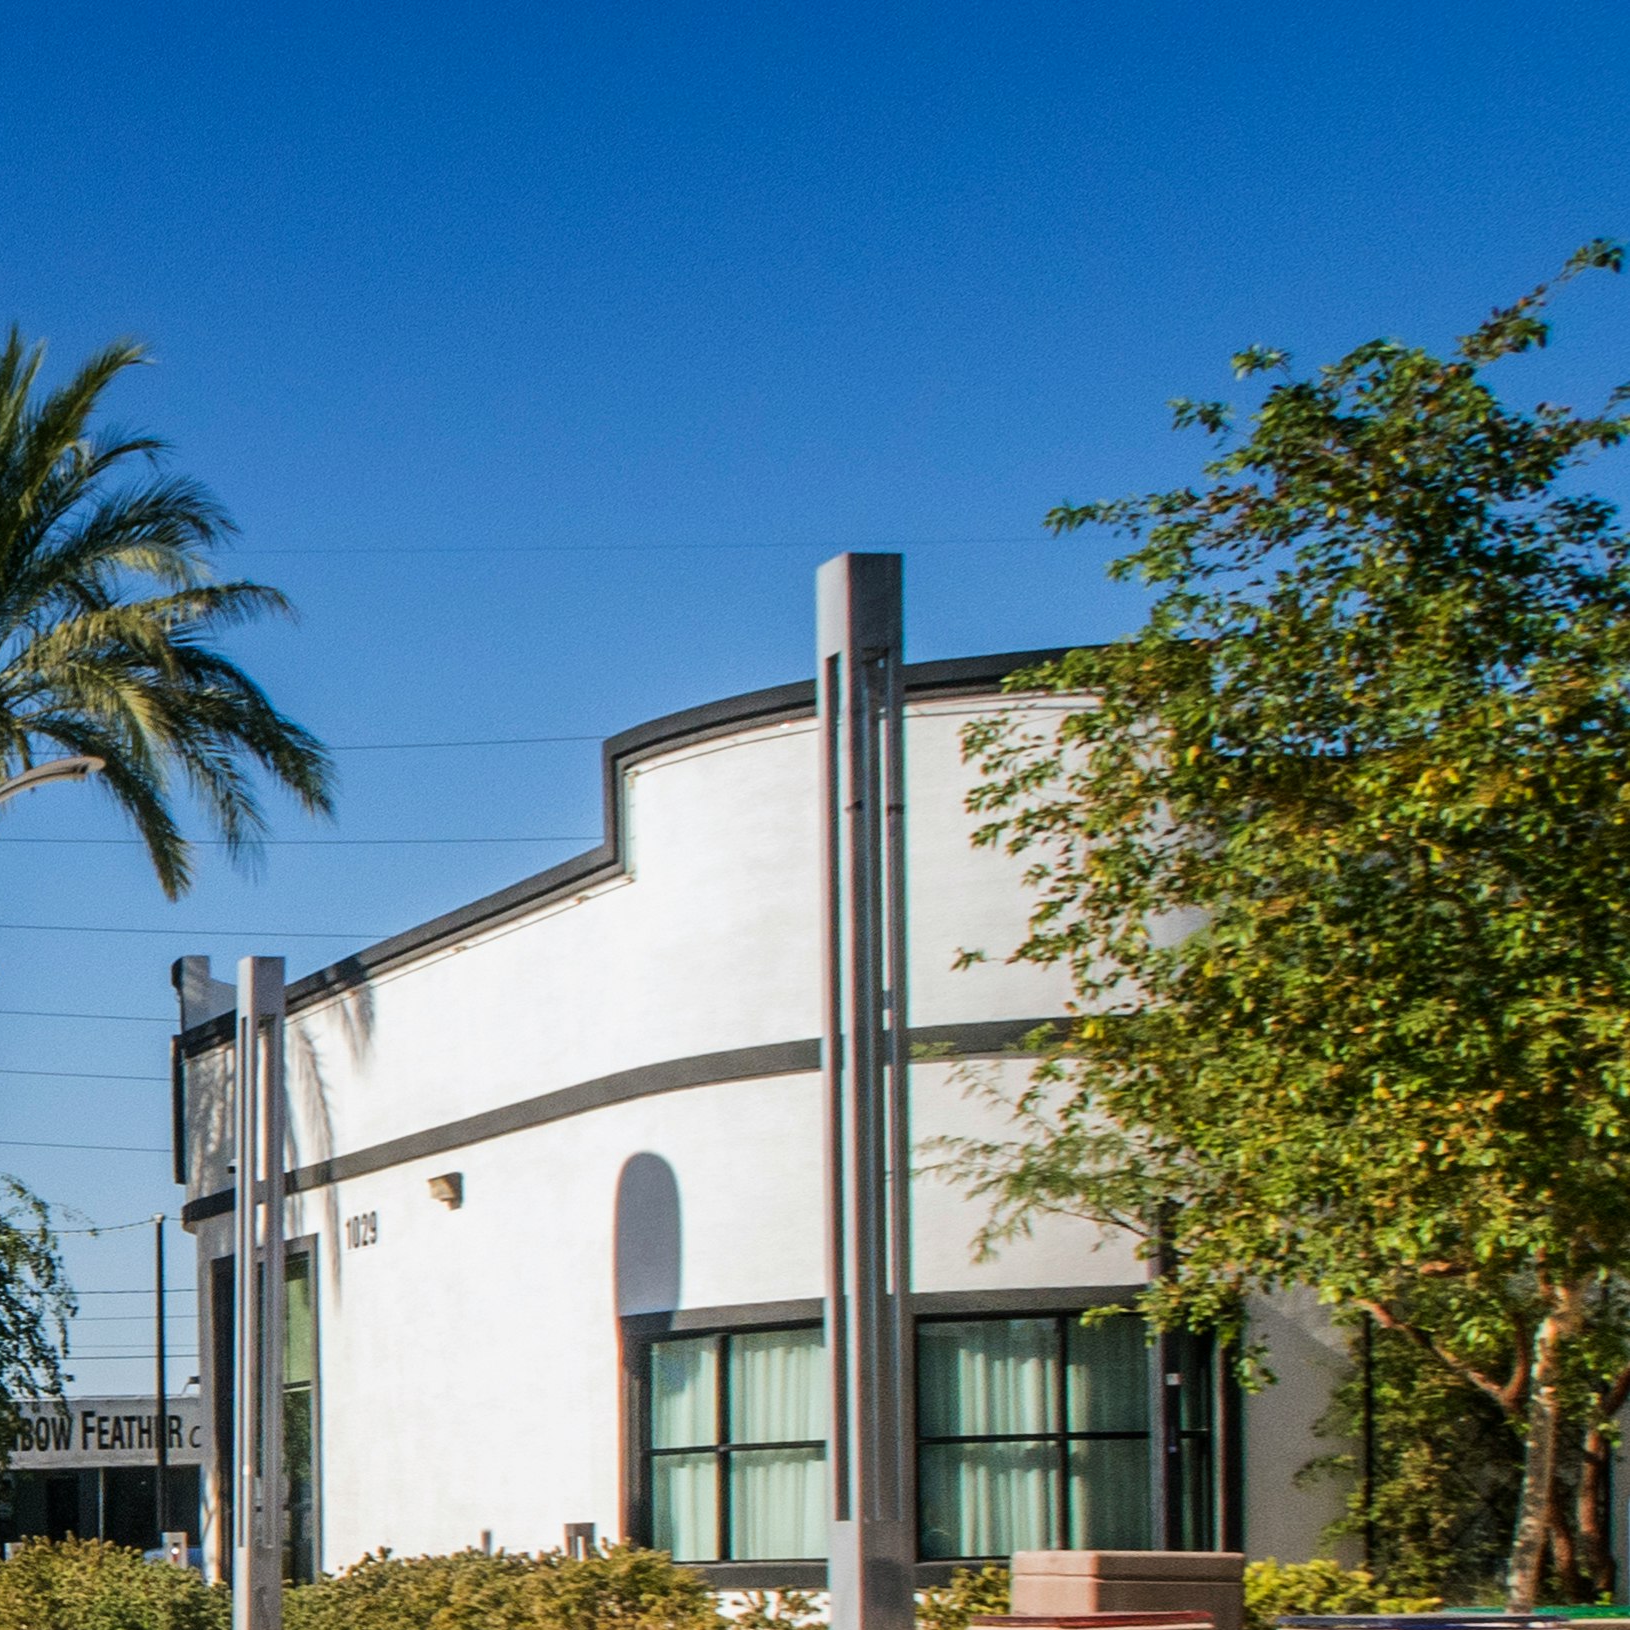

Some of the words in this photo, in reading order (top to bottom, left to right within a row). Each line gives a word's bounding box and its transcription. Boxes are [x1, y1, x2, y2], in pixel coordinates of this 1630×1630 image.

[345, 1210, 377, 1250] 1029
[11, 1416, 73, 1451] BOW
[81, 1411, 183, 1451] FEATHR
